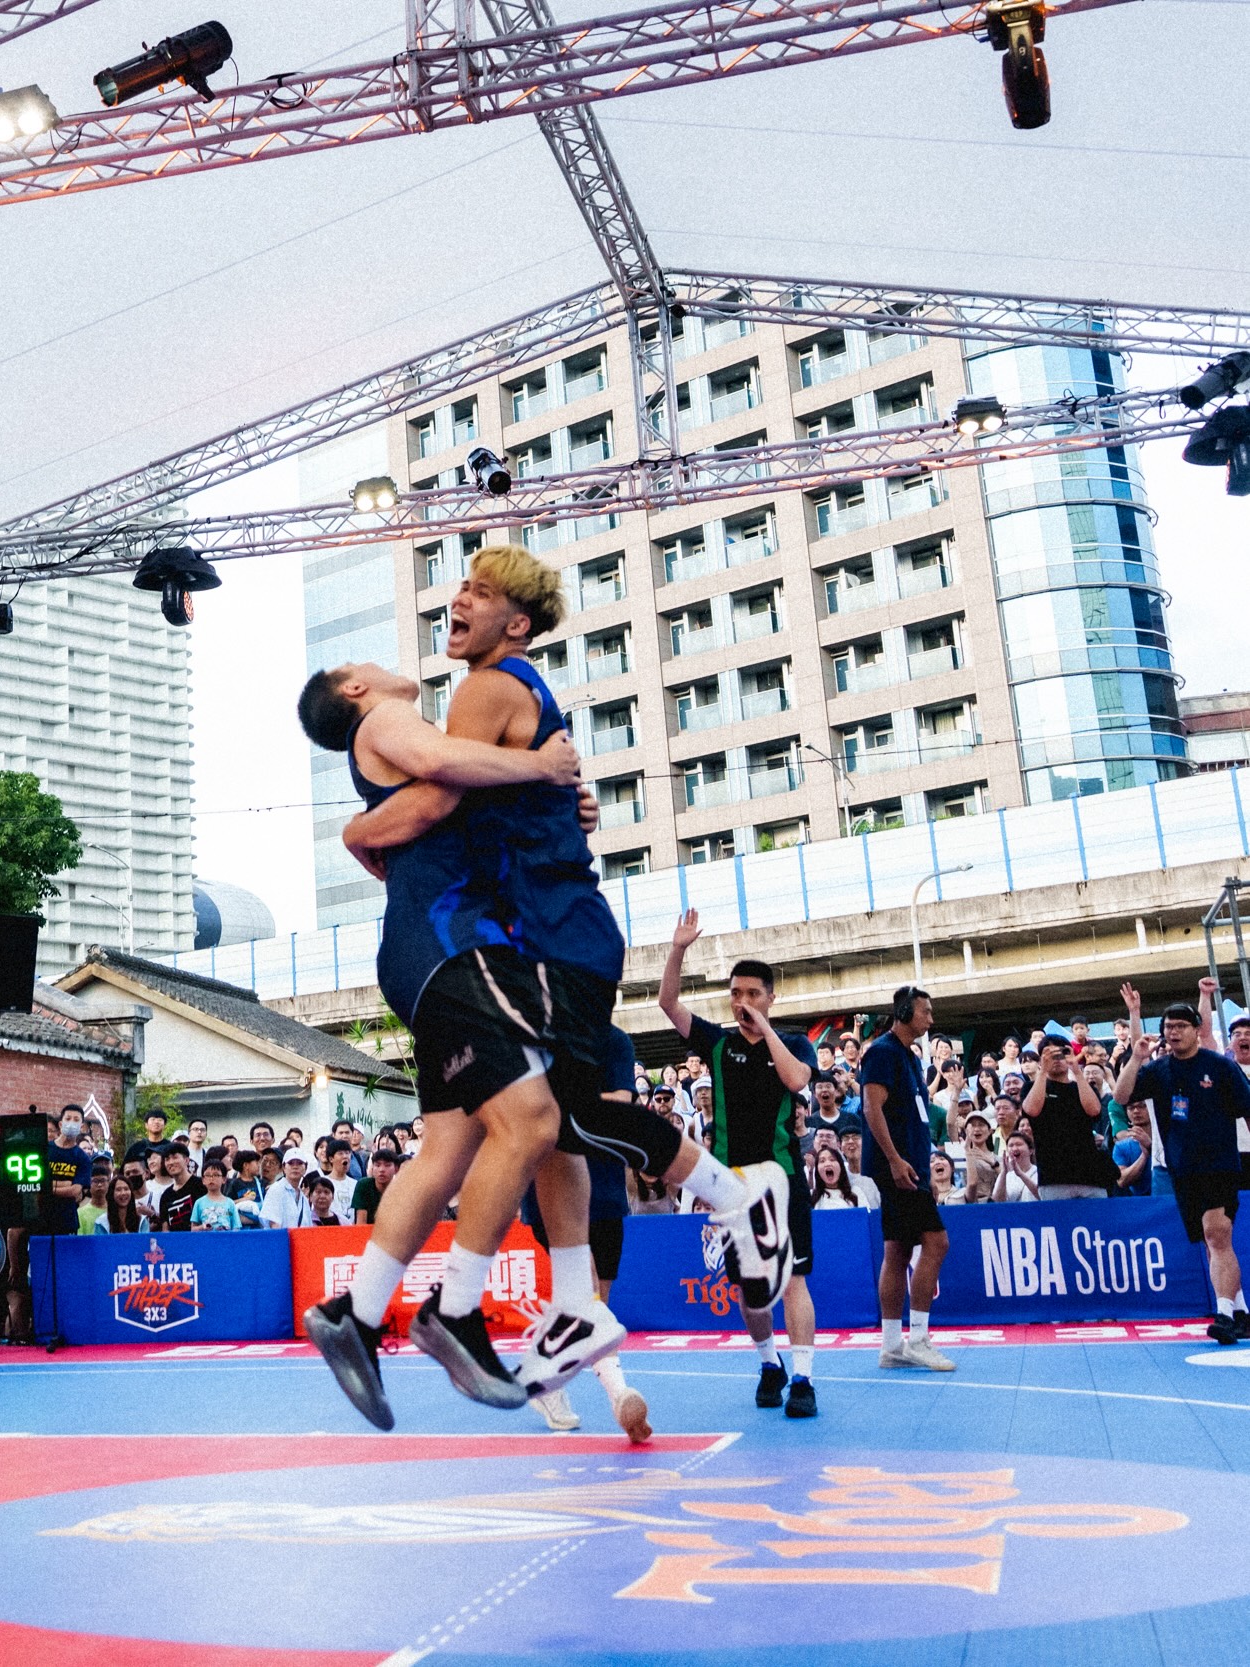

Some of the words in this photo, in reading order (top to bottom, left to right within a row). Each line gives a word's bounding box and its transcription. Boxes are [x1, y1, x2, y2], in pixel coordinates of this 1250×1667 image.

[6, 1154, 42, 1182] 95
[17, 1183, 41, 1193] FOULS
[980, 1226, 1068, 1297] NBA
[1071, 1226, 1167, 1295] Store
[117, 1264, 142, 1287] BE
[148, 1263, 194, 1286] LIKE
[680, 1275, 741, 1316] Tige
[143, 1306, 168, 1321] 3X3
[1055, 1323, 1214, 1339] 3X
[143, 1343, 307, 1358] BE
[613, 1466, 1190, 1604] Tiger
